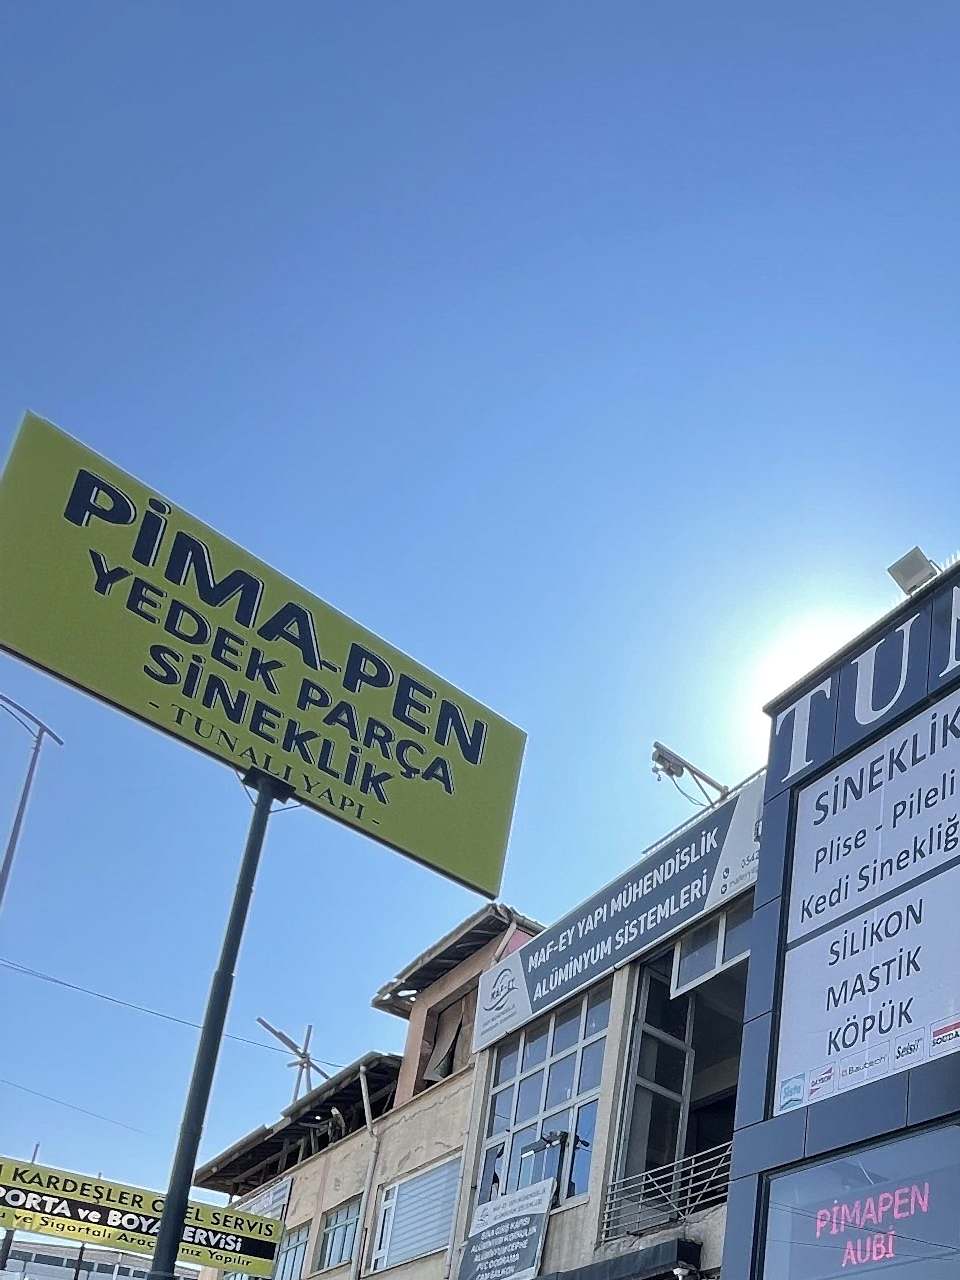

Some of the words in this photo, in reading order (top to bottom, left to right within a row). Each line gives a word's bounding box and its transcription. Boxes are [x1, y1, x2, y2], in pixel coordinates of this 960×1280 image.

[63, 468, 488, 766] PİMA-PEN
[88, 548, 286, 695] YEDEK
[297, 678, 456, 796] PARÇA
[143, 642, 397, 806] SİNEKLİK
[170, 702, 293, 782] TUNALI
[302, 773, 366, 822] YAPI
[814, 826, 867, 874] Plise
[893, 768, 956, 831] Pileli
[527, 925, 575, 973] MAF-EY
[577, 903, 607, 939] YAPI
[610, 826, 719, 917] MÜHENDİSLİK
[801, 874, 850, 925] Kedi
[828, 898, 923, 967] SİLİKON
[532, 935, 612, 1001] ALÜMİNYUM
[615, 868, 709, 951] SİSTEMLERİ
[826, 946, 922, 1012] MASTİK
[827, 998, 915, 1057] KÖPÜK
[12, 1167, 144, 1209] KARDEŞLER
[152, 1194, 205, 1222] ÖEL
[211, 1211, 274, 1237] SERVİS
[78, 1207, 102, 1223] ve
[816, 1182, 930, 1239] PİMAPEN
[15, 1216, 33, 1224] ve
[40, 1216, 112, 1240] Sigortalı
[208, 1249, 253, 1266] Yapılır
[842, 1225, 896, 1267] AUBİ
